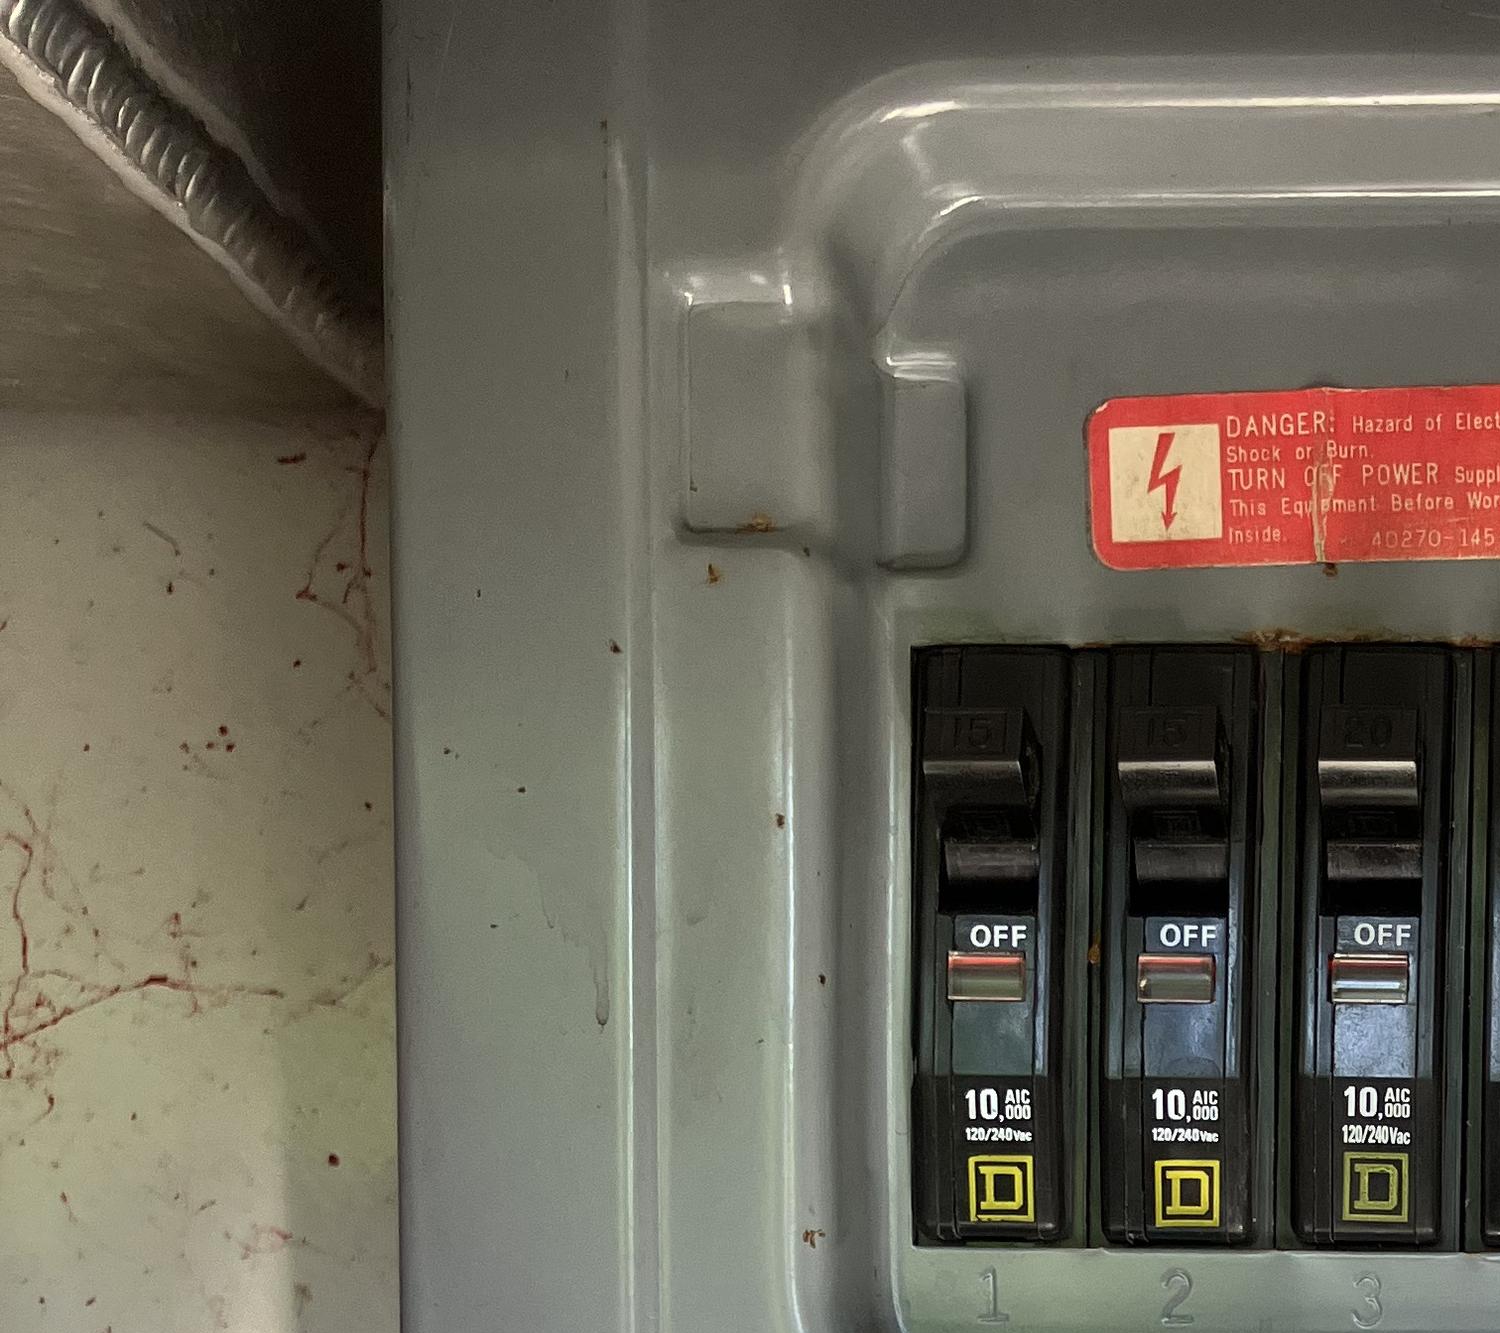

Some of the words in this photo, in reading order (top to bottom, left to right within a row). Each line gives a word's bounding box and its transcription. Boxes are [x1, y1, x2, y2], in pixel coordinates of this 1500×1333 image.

[1227, 411, 1335, 438] DANGER:
[1353, 415, 1412, 433] Hazard
[1425, 413, 1443, 431] of
[1227, 446, 1280, 463] Shock
[1296, 446, 1312, 460] or
[1228, 468, 1285, 491] TURN
[1363, 462, 1438, 486] POWER
[1230, 499, 1266, 517] This
[1282, 494, 1376, 518] Equpment
[1392, 493, 1454, 512] Before
[970, 925, 1027, 948] OFF
[1159, 924, 1217, 947] OFF
[1353, 923, 1412, 946] OFF
[1005, 1089, 1030, 1104] AIC
[1192, 1090, 1218, 1105] AIC
[1384, 1087, 1410, 1102] AIC
[977, 1267, 1010, 1323] 1
[1161, 1269, 1194, 1328] 2
[1352, 1271, 1383, 1329] 3
